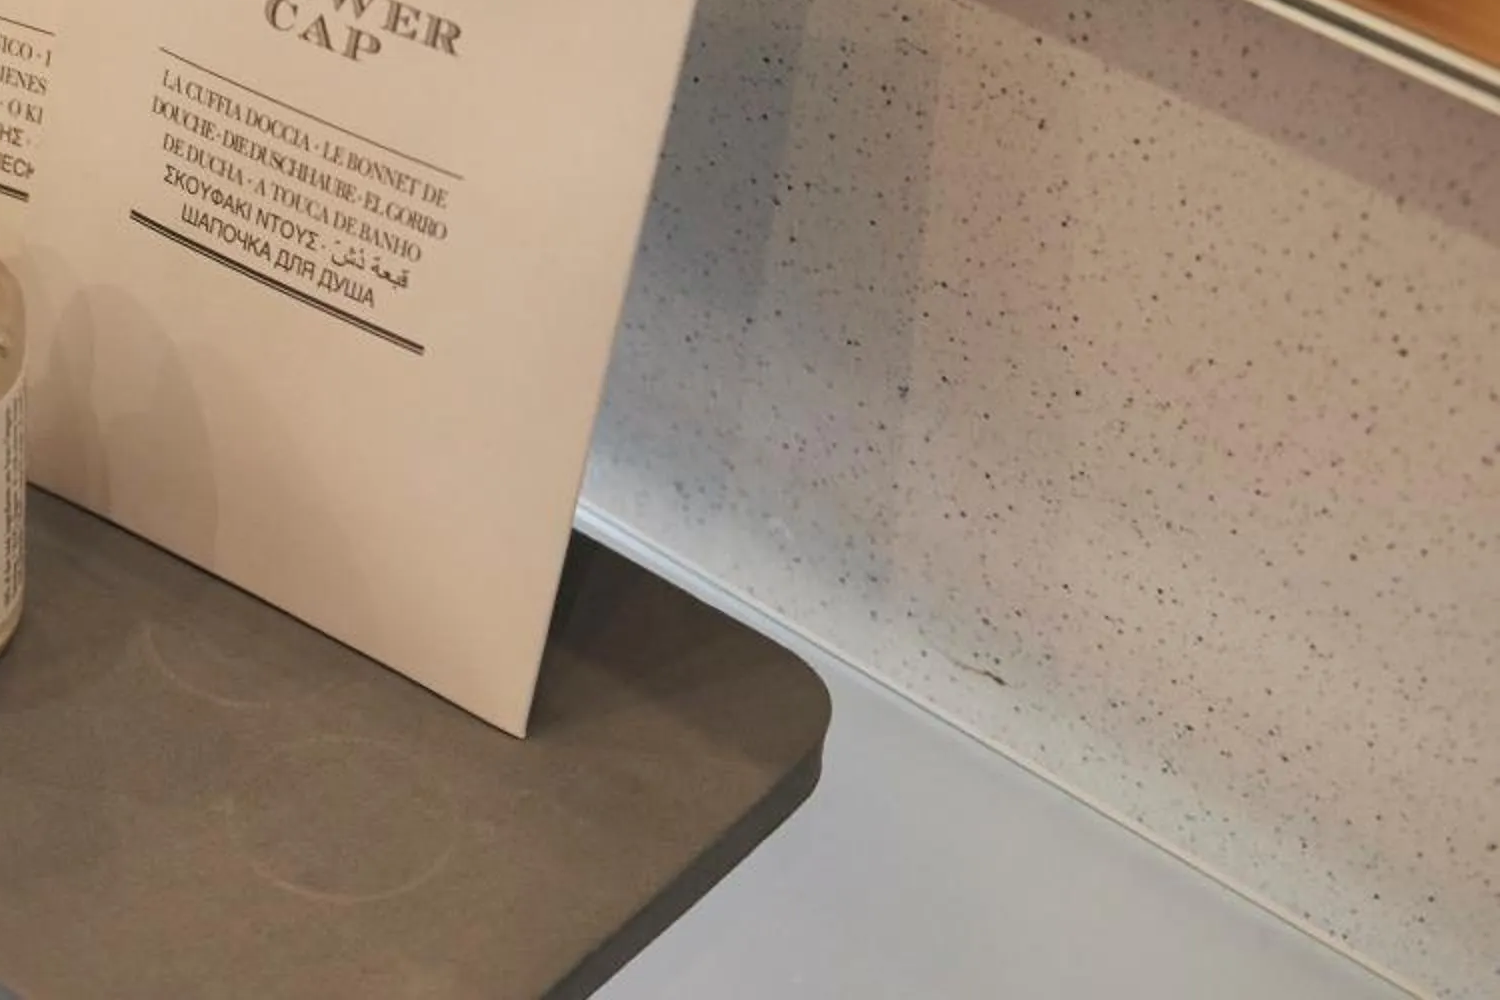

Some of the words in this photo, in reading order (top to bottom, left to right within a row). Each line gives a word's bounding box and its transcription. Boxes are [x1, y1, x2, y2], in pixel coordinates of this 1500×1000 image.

[7, 98, 22, 118] O
[151, 95, 216, 142] DOUCHE
[222, 128, 250, 156] DIE
[362, 190, 386, 216] EL
[384, 200, 448, 241] GORRO
[162, 68, 182, 95] LA
[184, 80, 242, 121] CUFFIA
[245, 107, 311, 152] DOCCIA
[322, 140, 345, 168] LE
[347, 151, 422, 199] BONNET
[424, 180, 449, 210] DE
[163, 132, 187, 157] DE
[187, 142, 243, 187] DUCHA
[253, 176, 267, 198] A
[271, 183, 330, 226] TOUCA
[332, 209, 358, 238] DE
[358, 221, 422, 263] BANHO
[181, 203, 272, 262] ШАПОЧКА
[274, 248, 316, 281] ДЛЯ
[317, 267, 376, 309] ДУША
